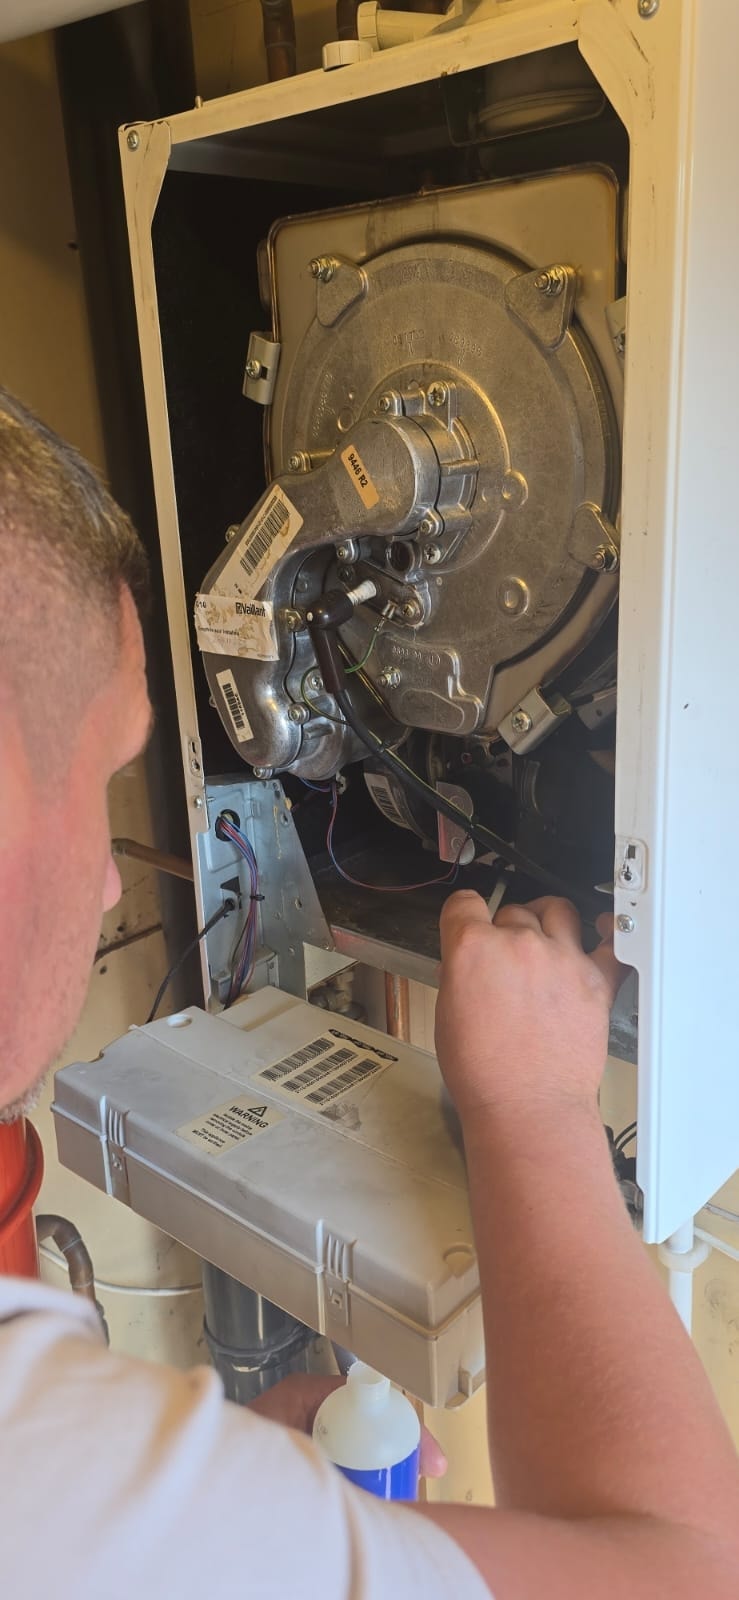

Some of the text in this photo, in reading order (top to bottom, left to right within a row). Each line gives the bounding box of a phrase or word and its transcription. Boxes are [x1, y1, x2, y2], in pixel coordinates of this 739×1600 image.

[358, 474, 368, 488] R2
[241, 602, 266, 617] Vaillant
[229, 1106, 269, 1128] WARNING
